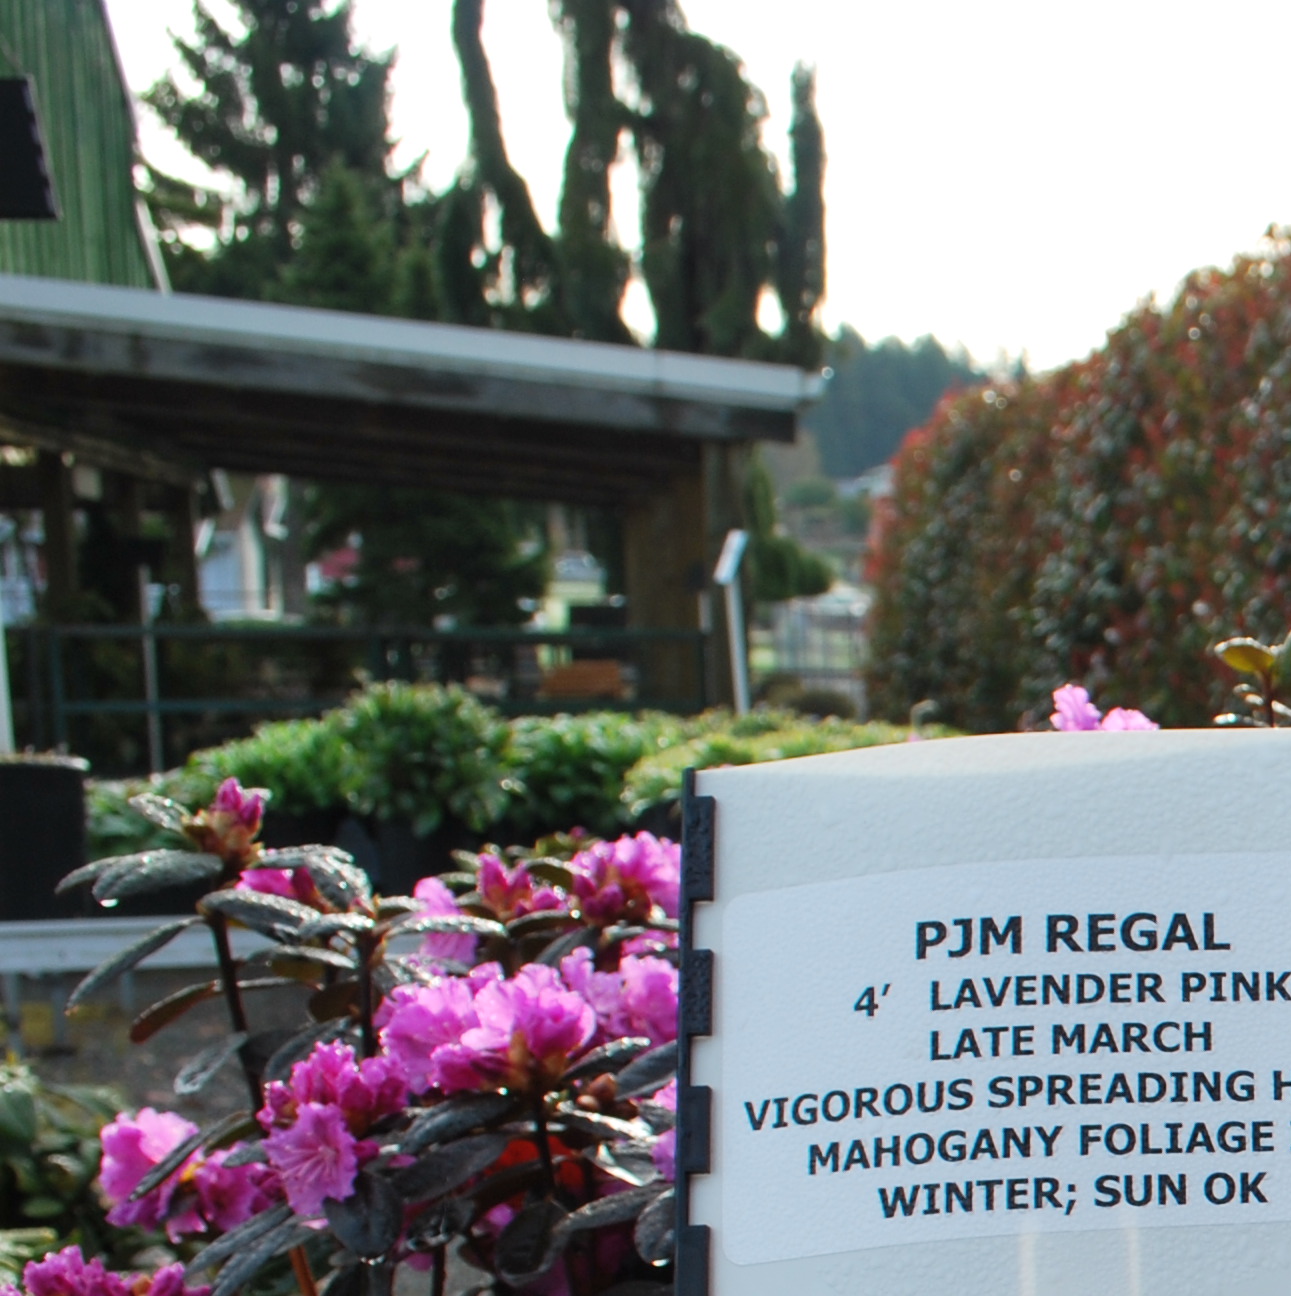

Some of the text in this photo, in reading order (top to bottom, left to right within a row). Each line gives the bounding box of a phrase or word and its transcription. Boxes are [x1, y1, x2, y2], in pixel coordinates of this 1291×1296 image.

[916, 912, 1231, 960] PJM REGAL
[931, 972, 1166, 1012] LAVENDER
[930, 1021, 1212, 1061] LATE MARCH
[744, 1078, 974, 1131] VIGOROUS
[988, 1070, 1255, 1109] SPREADING
[808, 1125, 1063, 1176] MAHOGANY
[1079, 1120, 1275, 1156] FOLIAGE
[878, 1171, 1268, 1219] WINTER; SUN OK
